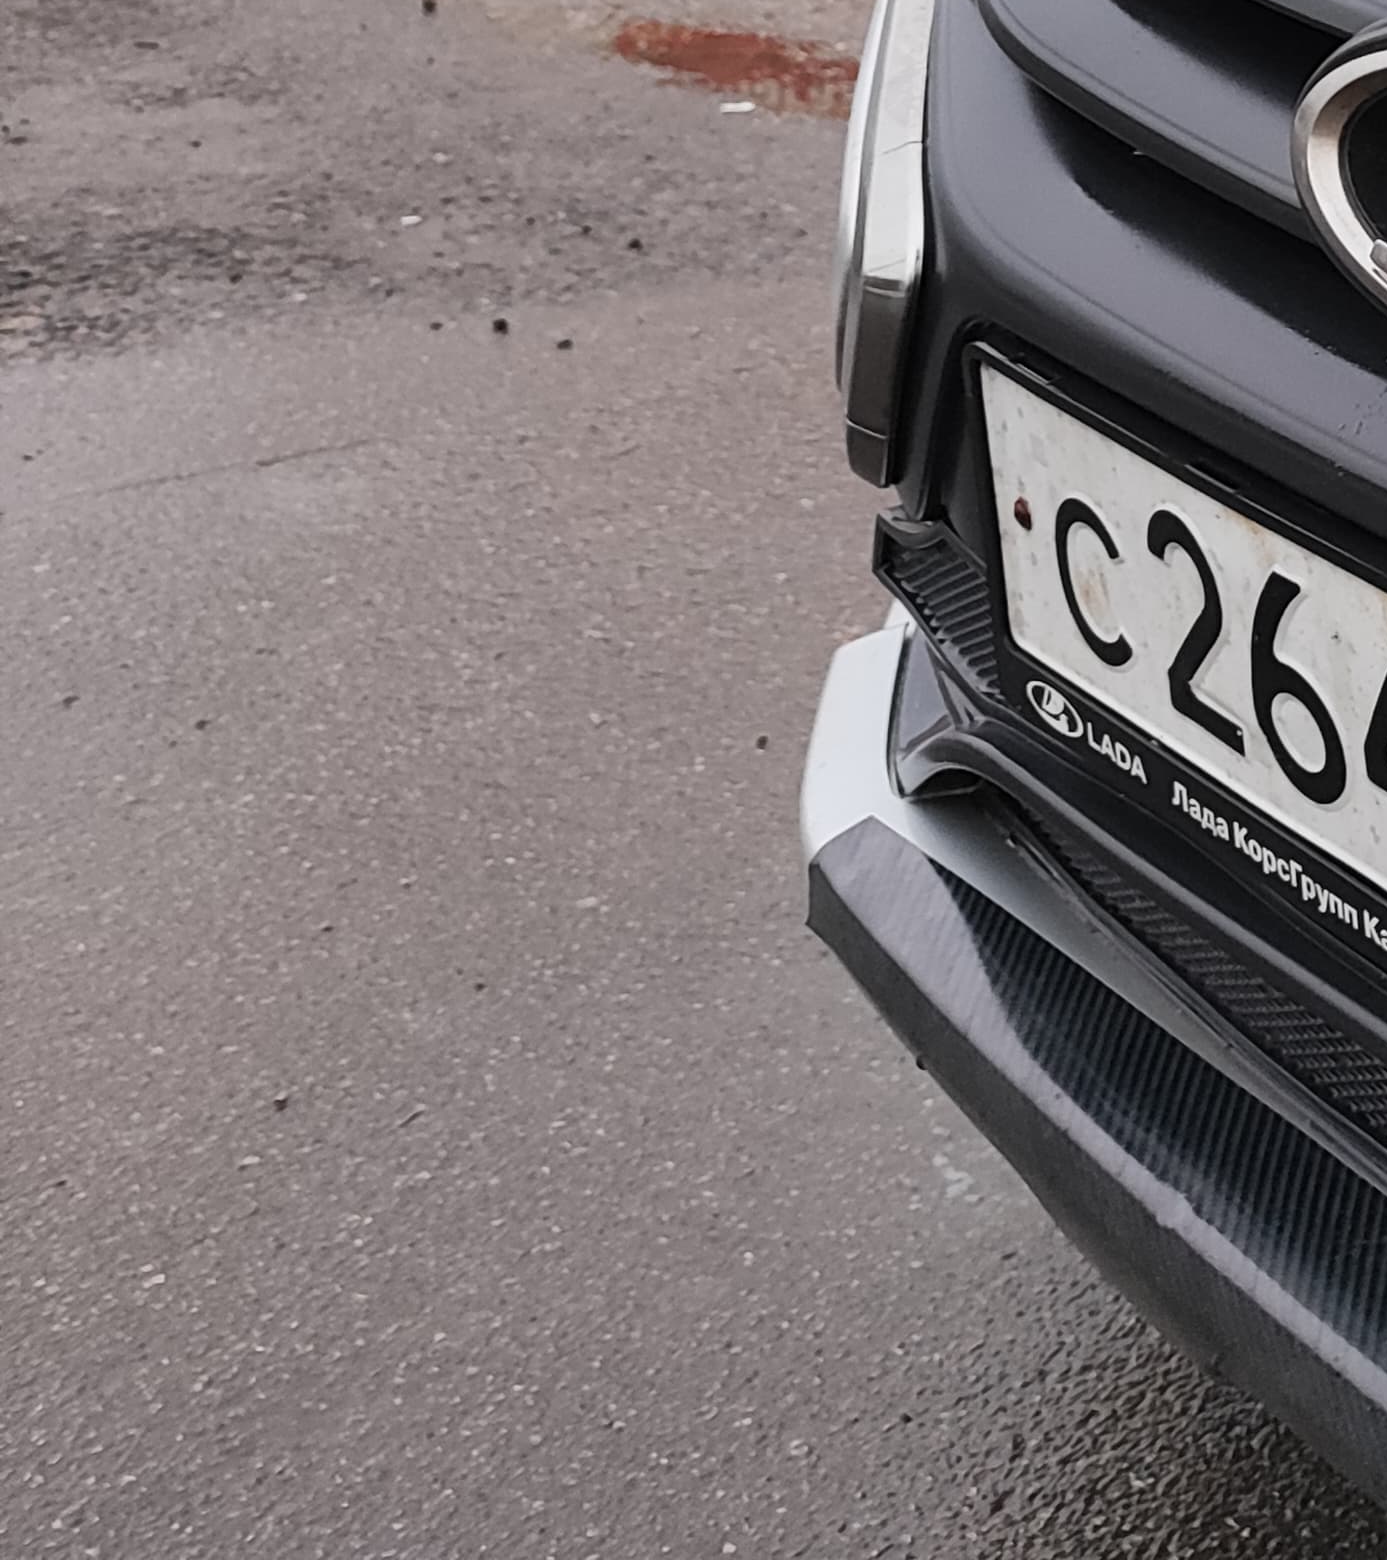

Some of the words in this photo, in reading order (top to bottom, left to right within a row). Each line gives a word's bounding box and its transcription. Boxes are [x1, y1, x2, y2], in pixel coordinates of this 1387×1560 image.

[1086, 722, 1149, 785] LADA
[1171, 780, 1230, 841] Лада
[1232, 820, 1359, 931] КорсГрупп
